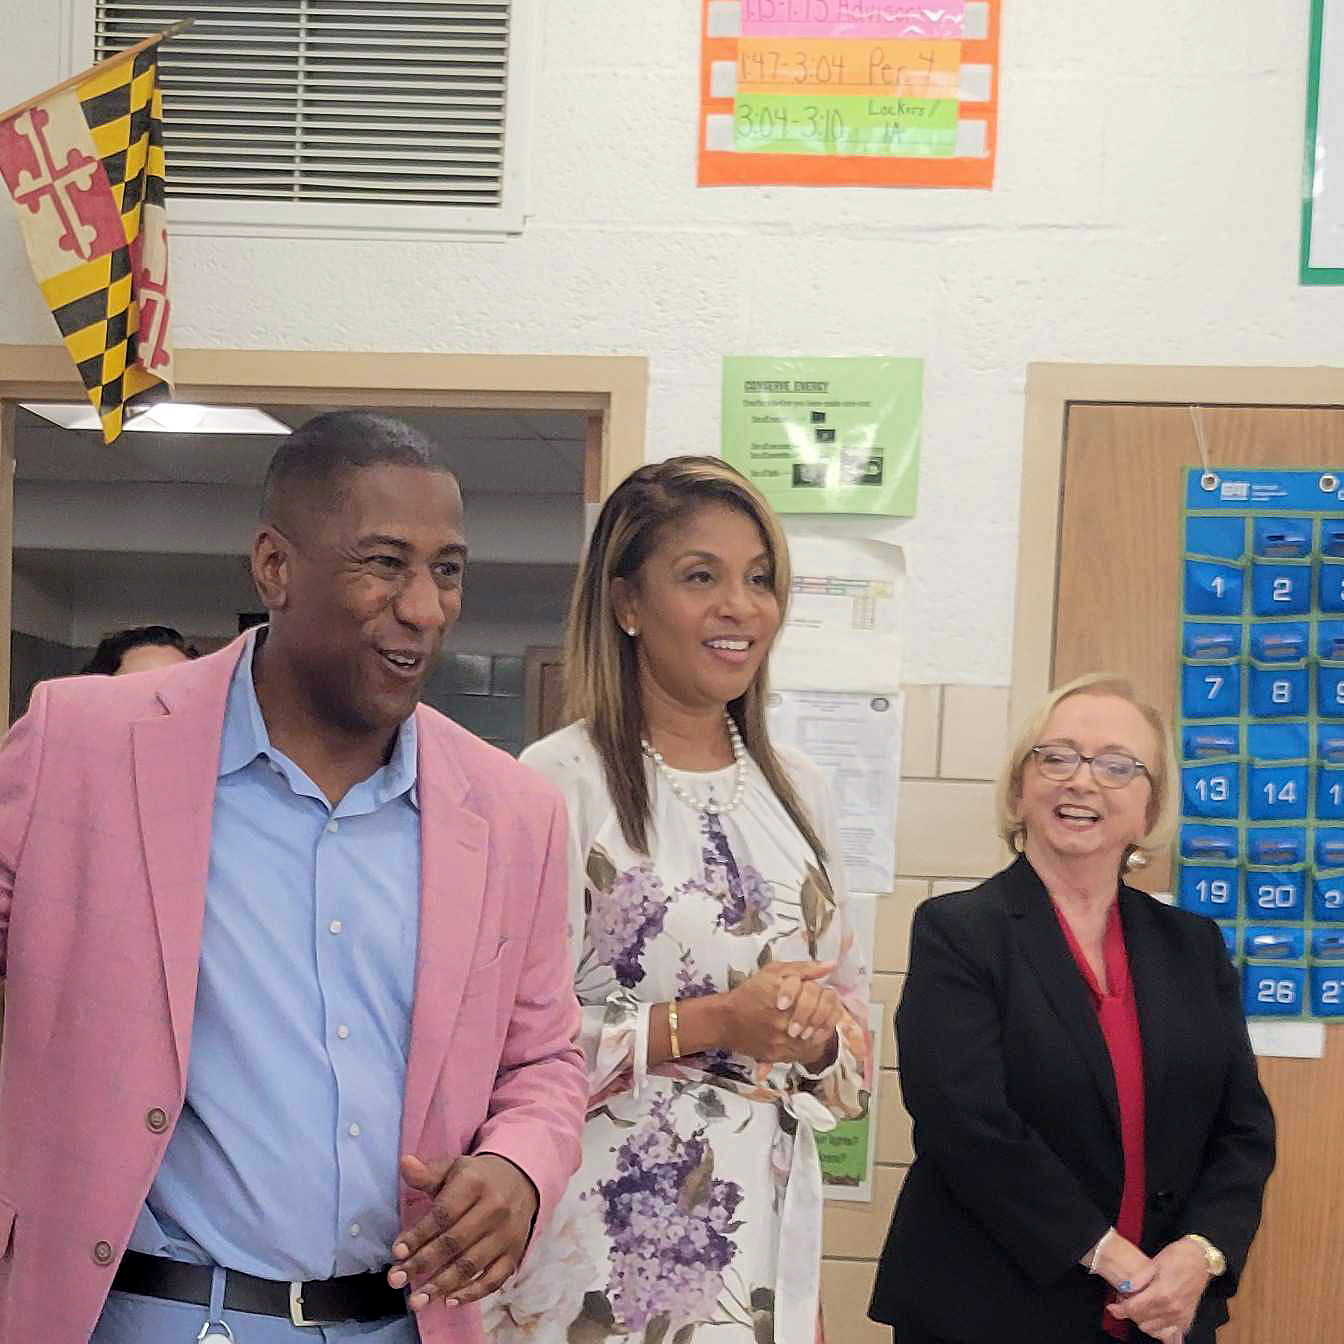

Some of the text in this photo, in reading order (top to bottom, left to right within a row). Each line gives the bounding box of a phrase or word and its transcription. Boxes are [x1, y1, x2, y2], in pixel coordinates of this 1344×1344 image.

[1210, 576, 1224, 596] 1
[1272, 578, 1293, 601] 2
[1204, 677, 1224, 699] 7
[1271, 681, 1292, 704] 8
[1194, 777, 1230, 801] 13
[1262, 781, 1297, 804] 14
[1194, 878, 1230, 902] 19
[1257, 885, 1296, 909] 20
[1257, 979, 1295, 1004] 26
